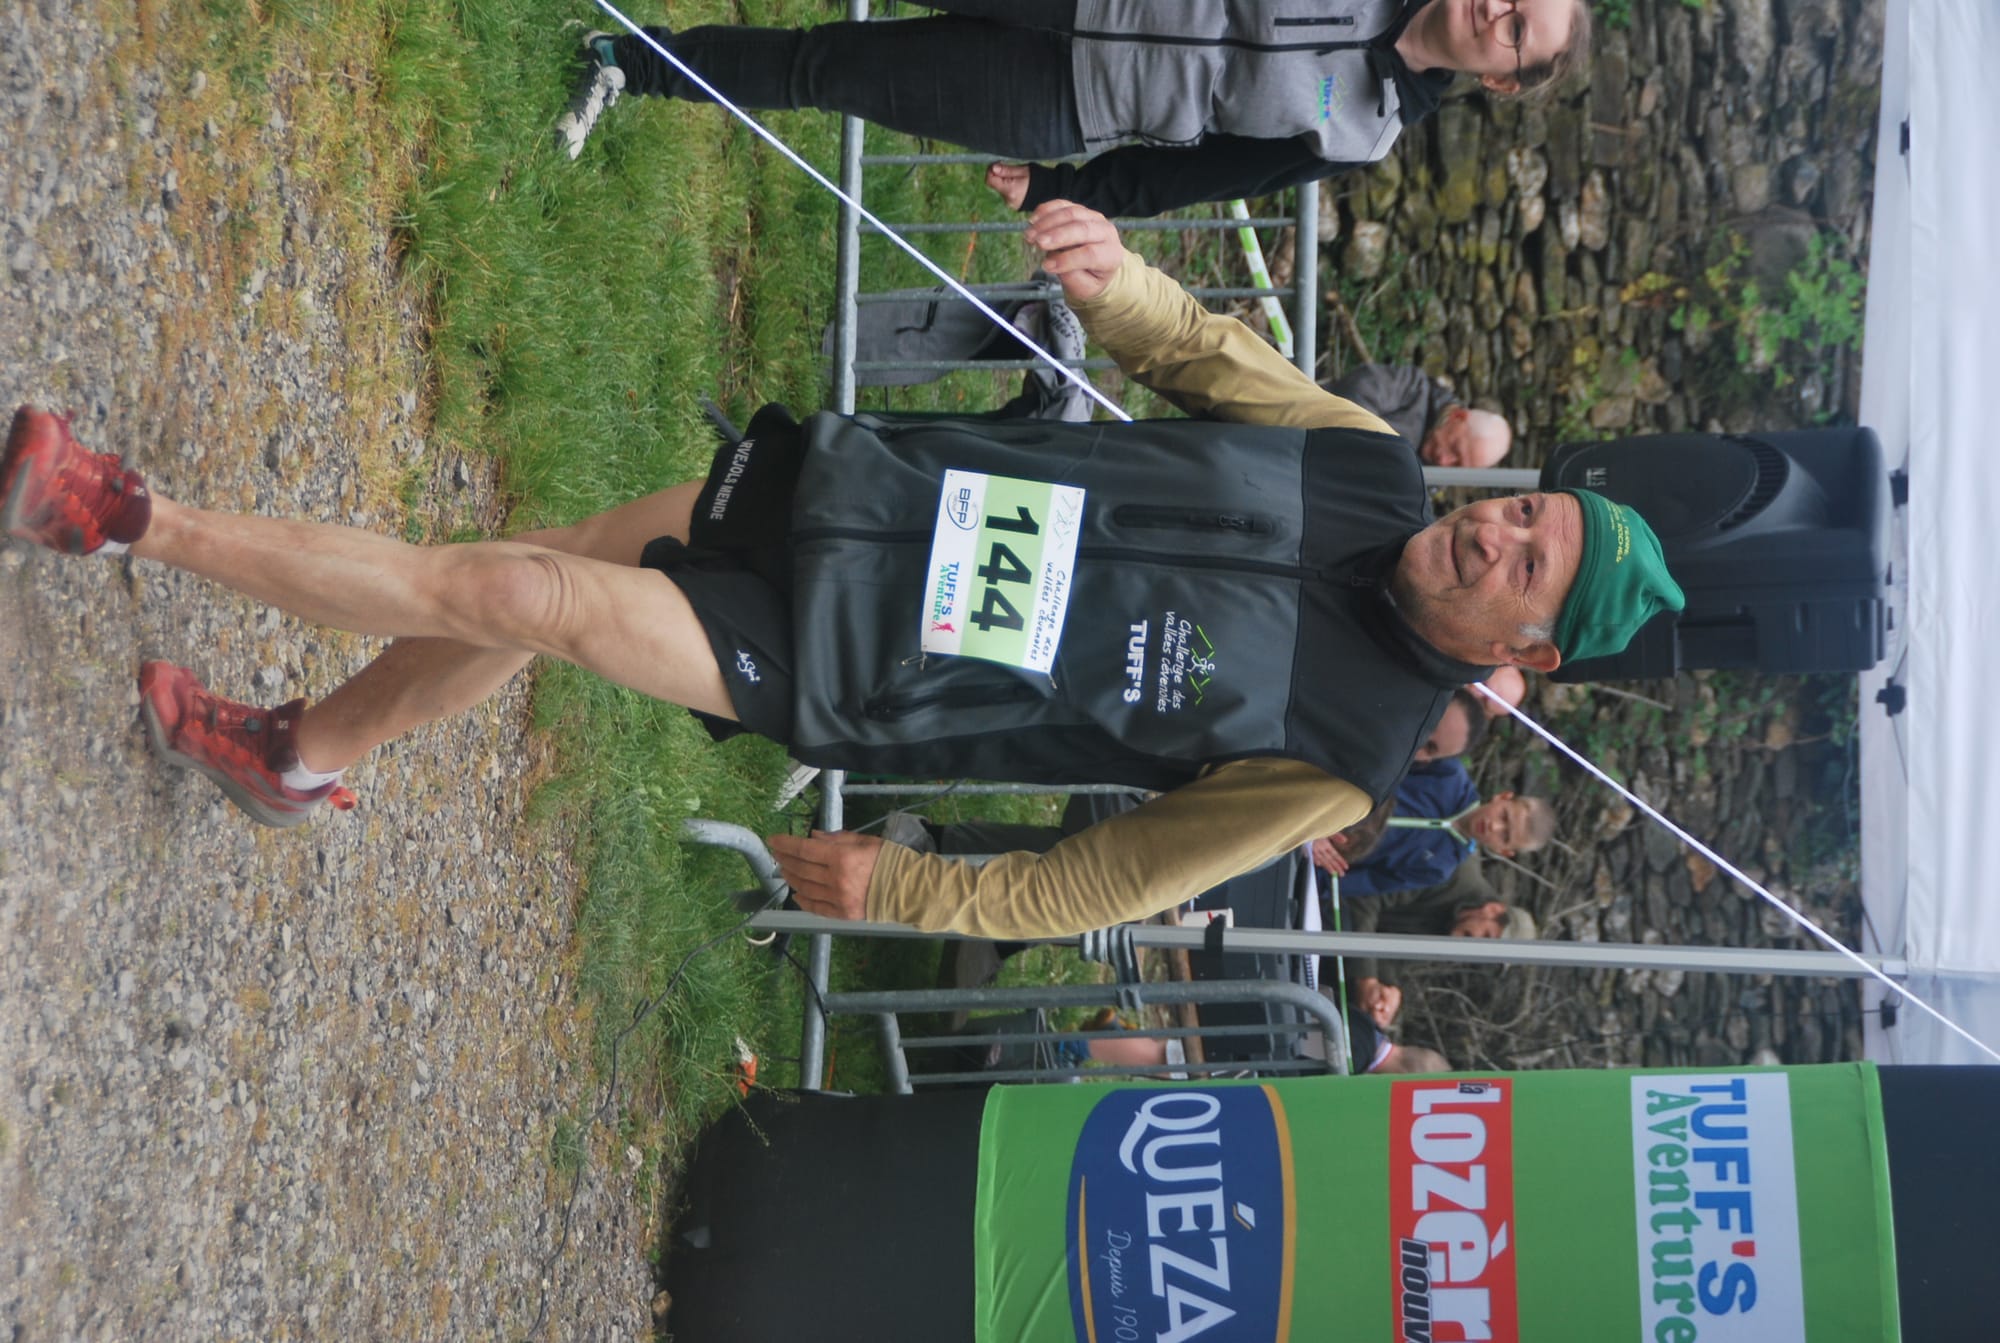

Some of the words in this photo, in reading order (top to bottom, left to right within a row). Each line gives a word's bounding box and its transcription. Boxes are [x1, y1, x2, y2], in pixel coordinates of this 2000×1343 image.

[710, 485, 734, 520] MENDE
[959, 488, 971, 523] BFP
[933, 566, 949, 620] Aventure
[942, 562, 959, 615] TUFF'S
[970, 506, 1040, 632] 144
[1041, 561, 1054, 602] vallées
[1045, 569, 1066, 630] Challenge
[1031, 608, 1048, 661] cévenoles
[1042, 637, 1054, 657] des
[1123, 619, 1148, 702] TUFF'S
[1162, 611, 1177, 655] vallées
[1173, 619, 1192, 684] Challenge
[1157, 657, 1173, 713] cévenoles
[1173, 689, 1186, 710] des
[1119, 1092, 1256, 1343] QUÉZA
[1410, 1087, 1508, 1343] Lozèr
[1646, 1089, 1702, 1343] Aventure
[1690, 1079, 1757, 1316] TUFF'S
[1100, 1229, 1132, 1298] Depuis
[1113, 1304, 1140, 1343] 190
